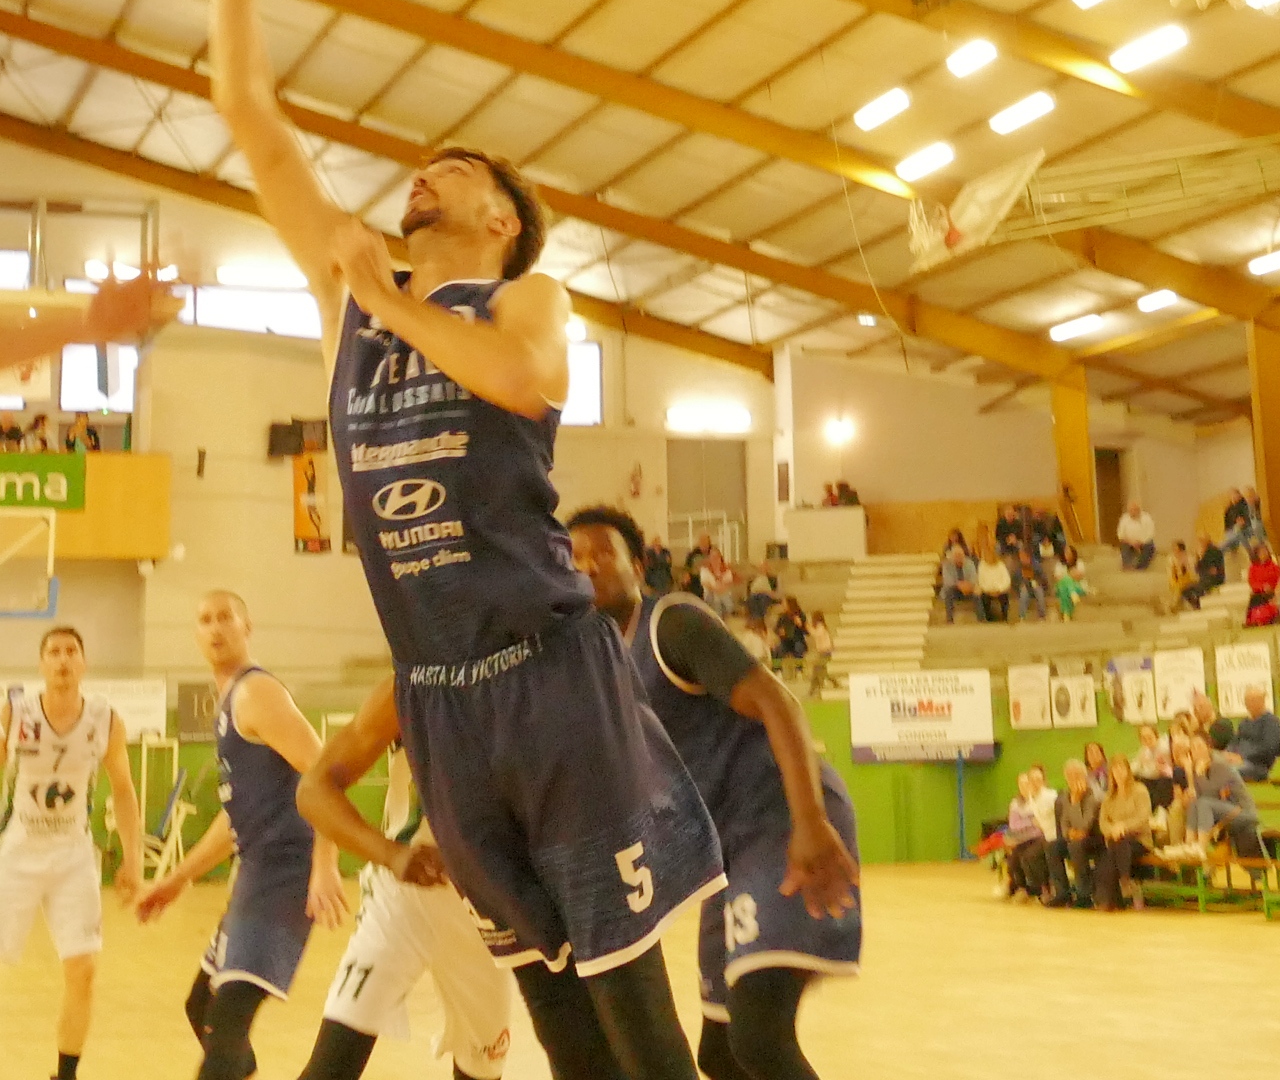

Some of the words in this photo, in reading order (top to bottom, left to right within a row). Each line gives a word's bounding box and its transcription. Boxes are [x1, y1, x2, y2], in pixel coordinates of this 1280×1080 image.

[410, 664, 448, 687] HASTA
[471, 638, 533, 686] VICTORIA
[52, 743, 68, 773] 7
[615, 841, 655, 914] 5
[336, 962, 374, 1003] 11
